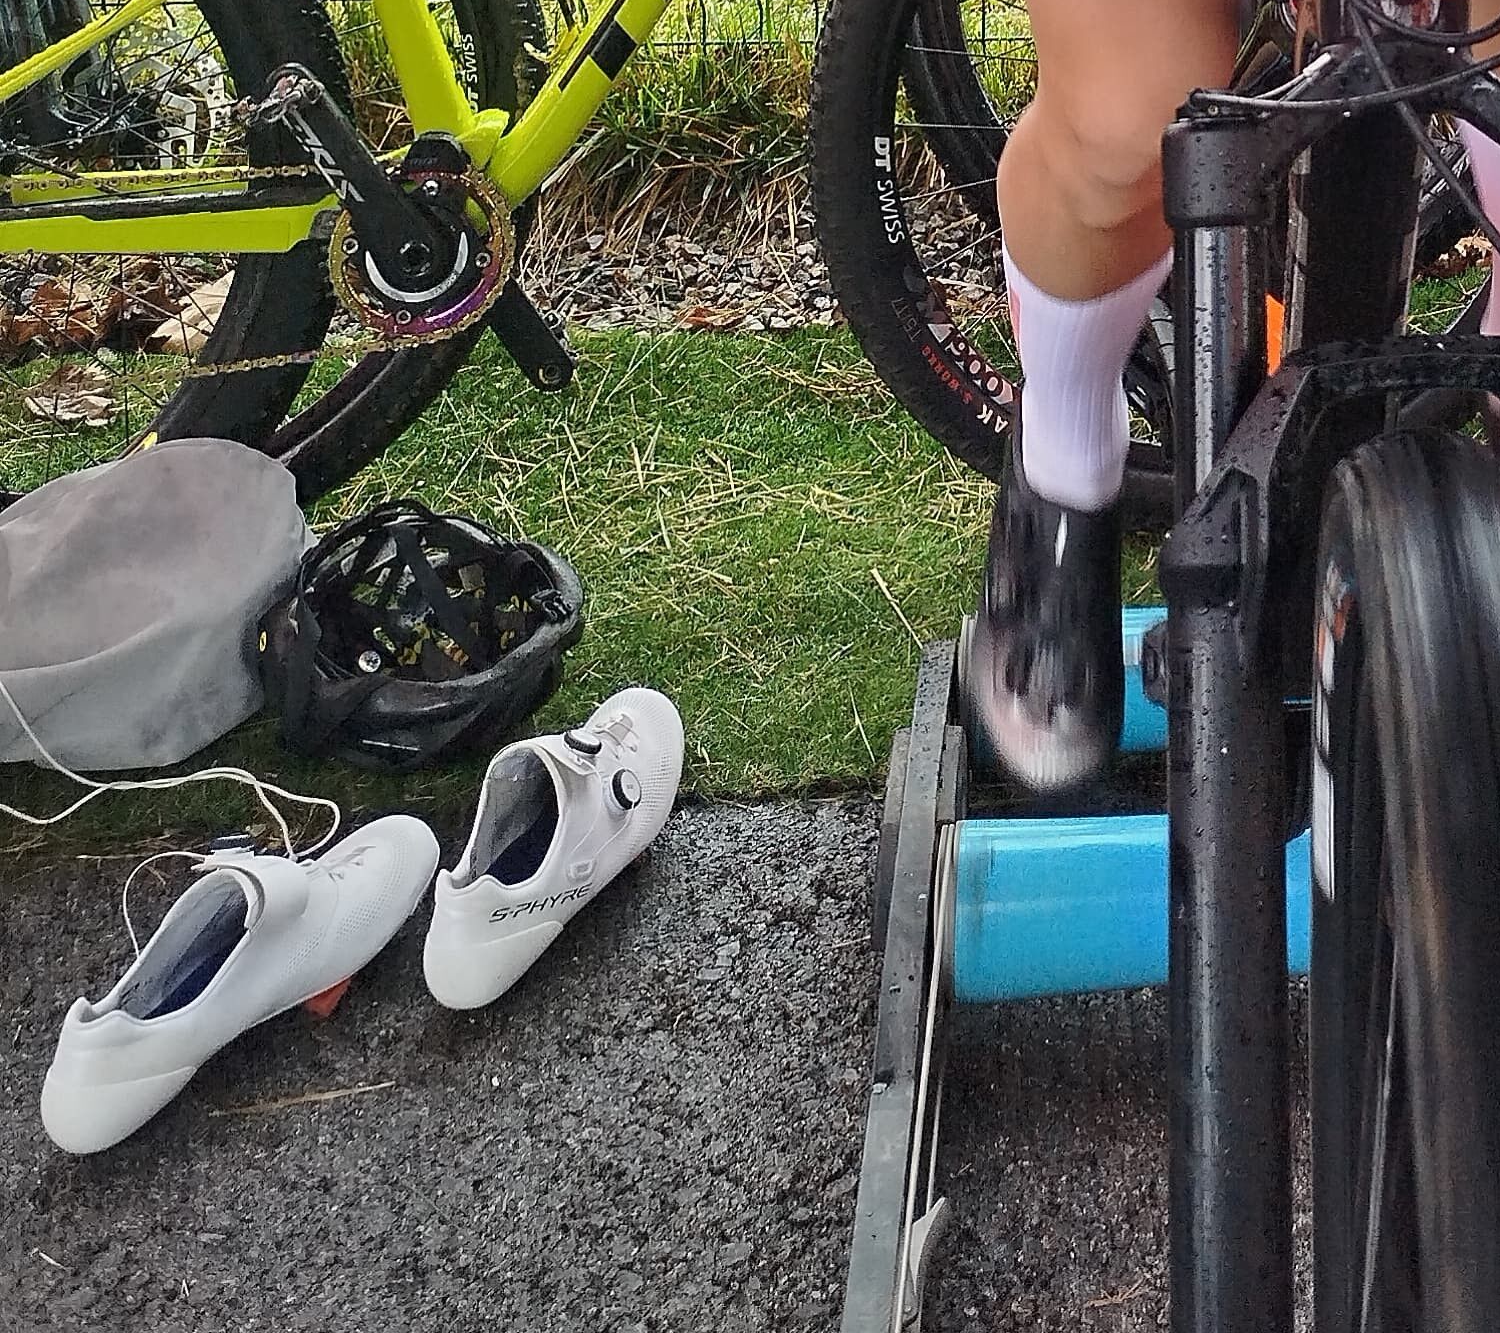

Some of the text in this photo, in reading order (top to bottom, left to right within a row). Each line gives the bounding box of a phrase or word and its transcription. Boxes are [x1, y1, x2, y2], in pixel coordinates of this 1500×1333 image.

[462, 32, 478, 84] SWISS
[874, 136, 905, 244] DT SWISS
[488, 882, 593, 924] S-PHYRE
